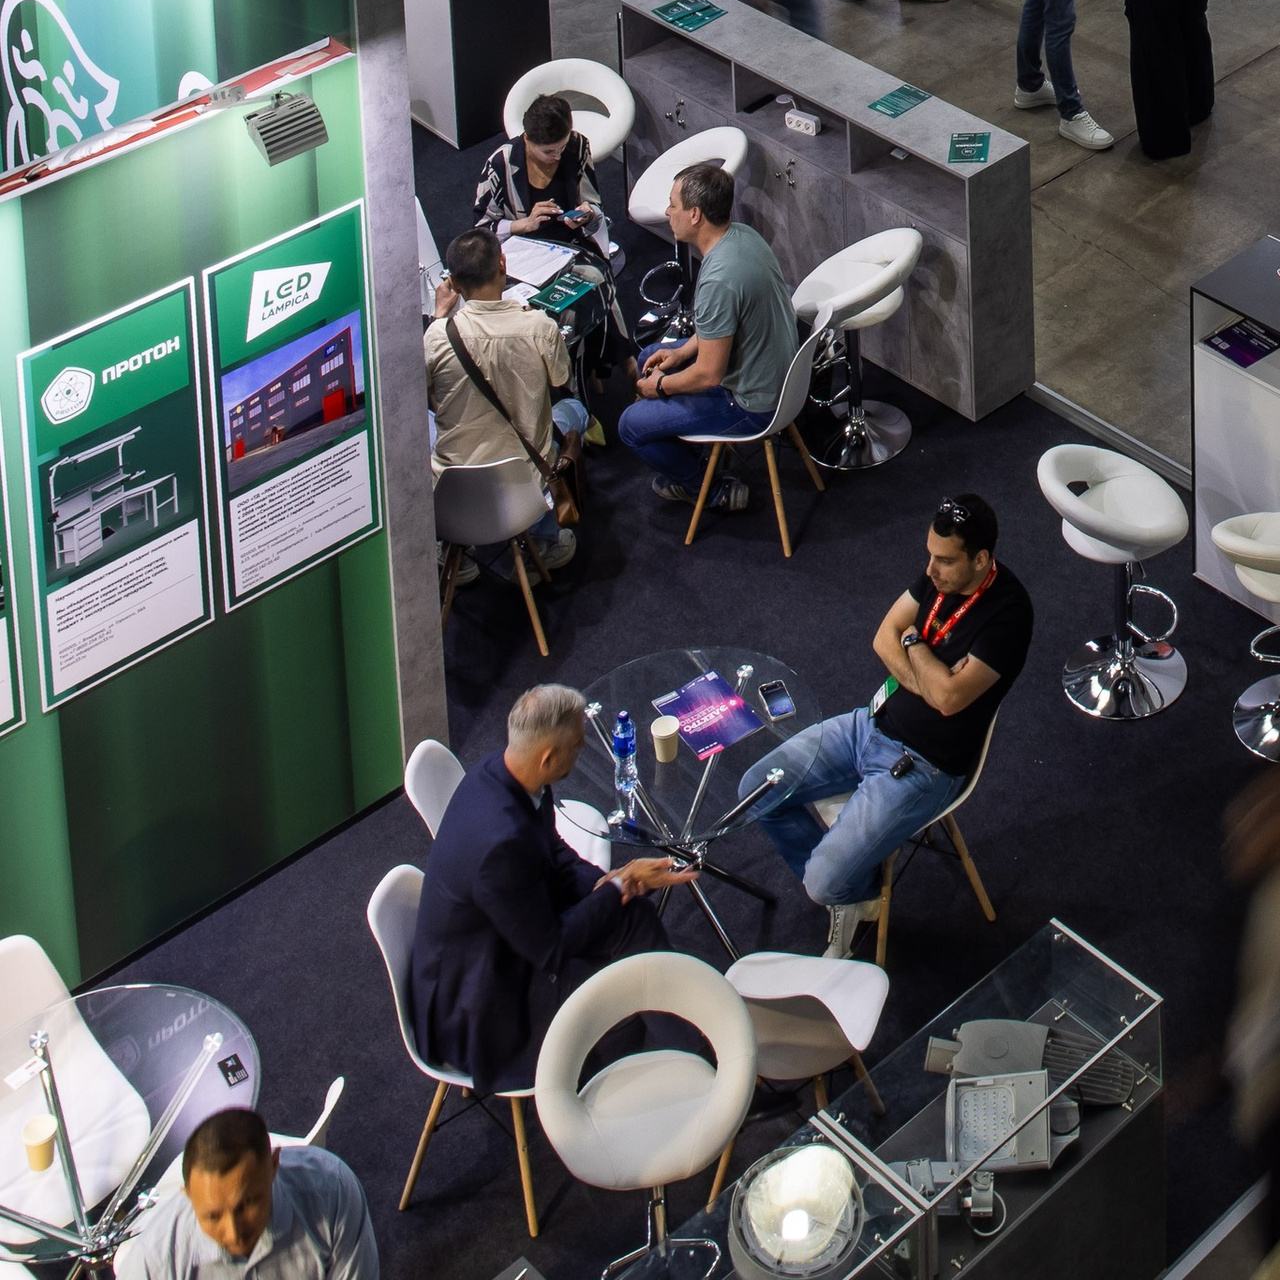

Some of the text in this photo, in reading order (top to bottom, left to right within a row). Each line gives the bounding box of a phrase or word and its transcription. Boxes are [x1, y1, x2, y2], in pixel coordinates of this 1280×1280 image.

[261, 291, 310, 322] LAMPICA
[263, 271, 312, 308] LED
[102, 335, 180, 385] ПРОТОН
[55, 399, 85, 416] PROTON
